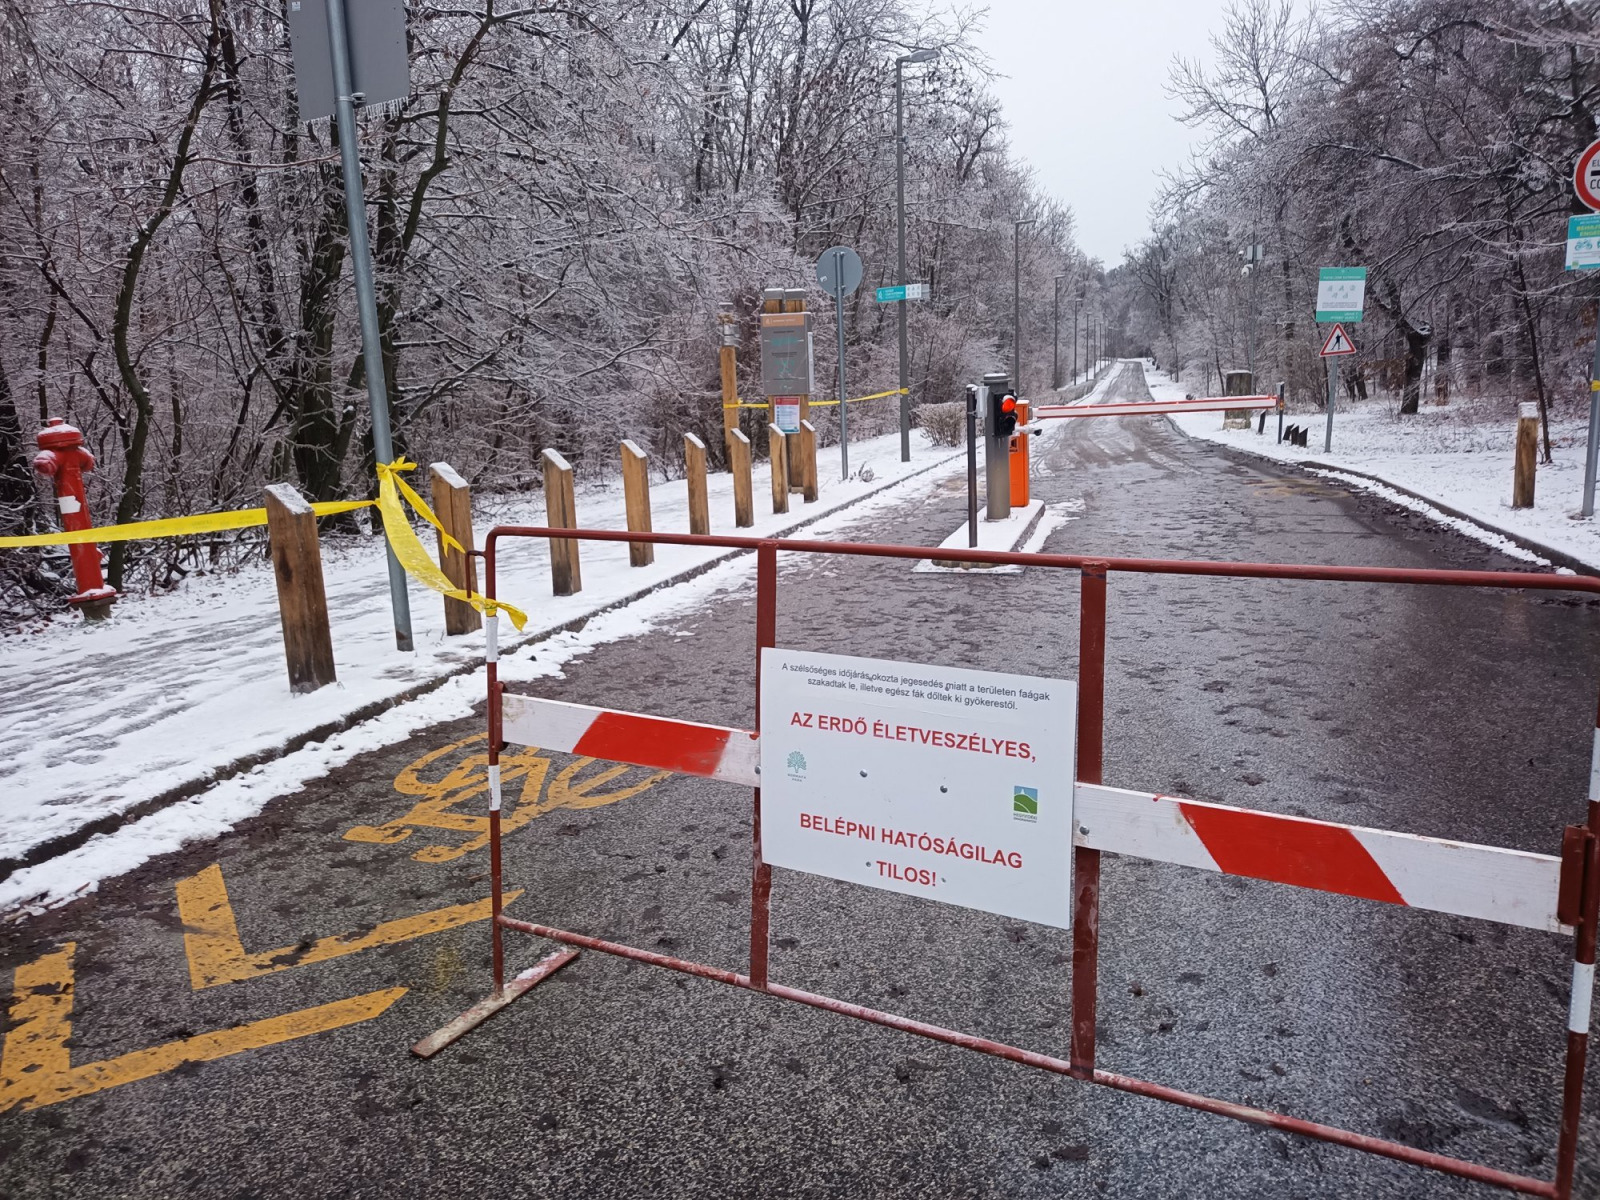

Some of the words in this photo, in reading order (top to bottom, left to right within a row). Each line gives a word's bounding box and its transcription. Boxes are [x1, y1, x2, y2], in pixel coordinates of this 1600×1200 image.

[782, 663, 788, 671] A
[790, 664, 837, 676] szélsőséges
[839, 669, 870, 680] időjárás
[871, 672, 899, 683] okozta
[900, 676, 943, 688] jegesedés
[945, 682, 967, 691] miatt
[977, 685, 1017, 697] területen
[1018, 689, 1051, 702] faágak
[808, 678, 847, 689] szakadtak
[848, 682, 858, 692] le,
[859, 684, 883, 694] illetve
[885, 687, 910, 698] egész
[912, 689, 925, 699] fák
[926, 691, 953, 703] dőltek
[954, 694, 963, 704] ki
[964, 697, 1018, 710] gyökerestől.
[790, 712, 813, 728] AZ
[818, 714, 868, 735] ERDŐ
[872, 719, 1036, 763] ÉLETVESZÉLYES,
[800, 812, 876, 841] BELÉPNI
[881, 828, 1023, 869] HATÓSÁGILAG
[876, 860, 937, 887] TILOS!
